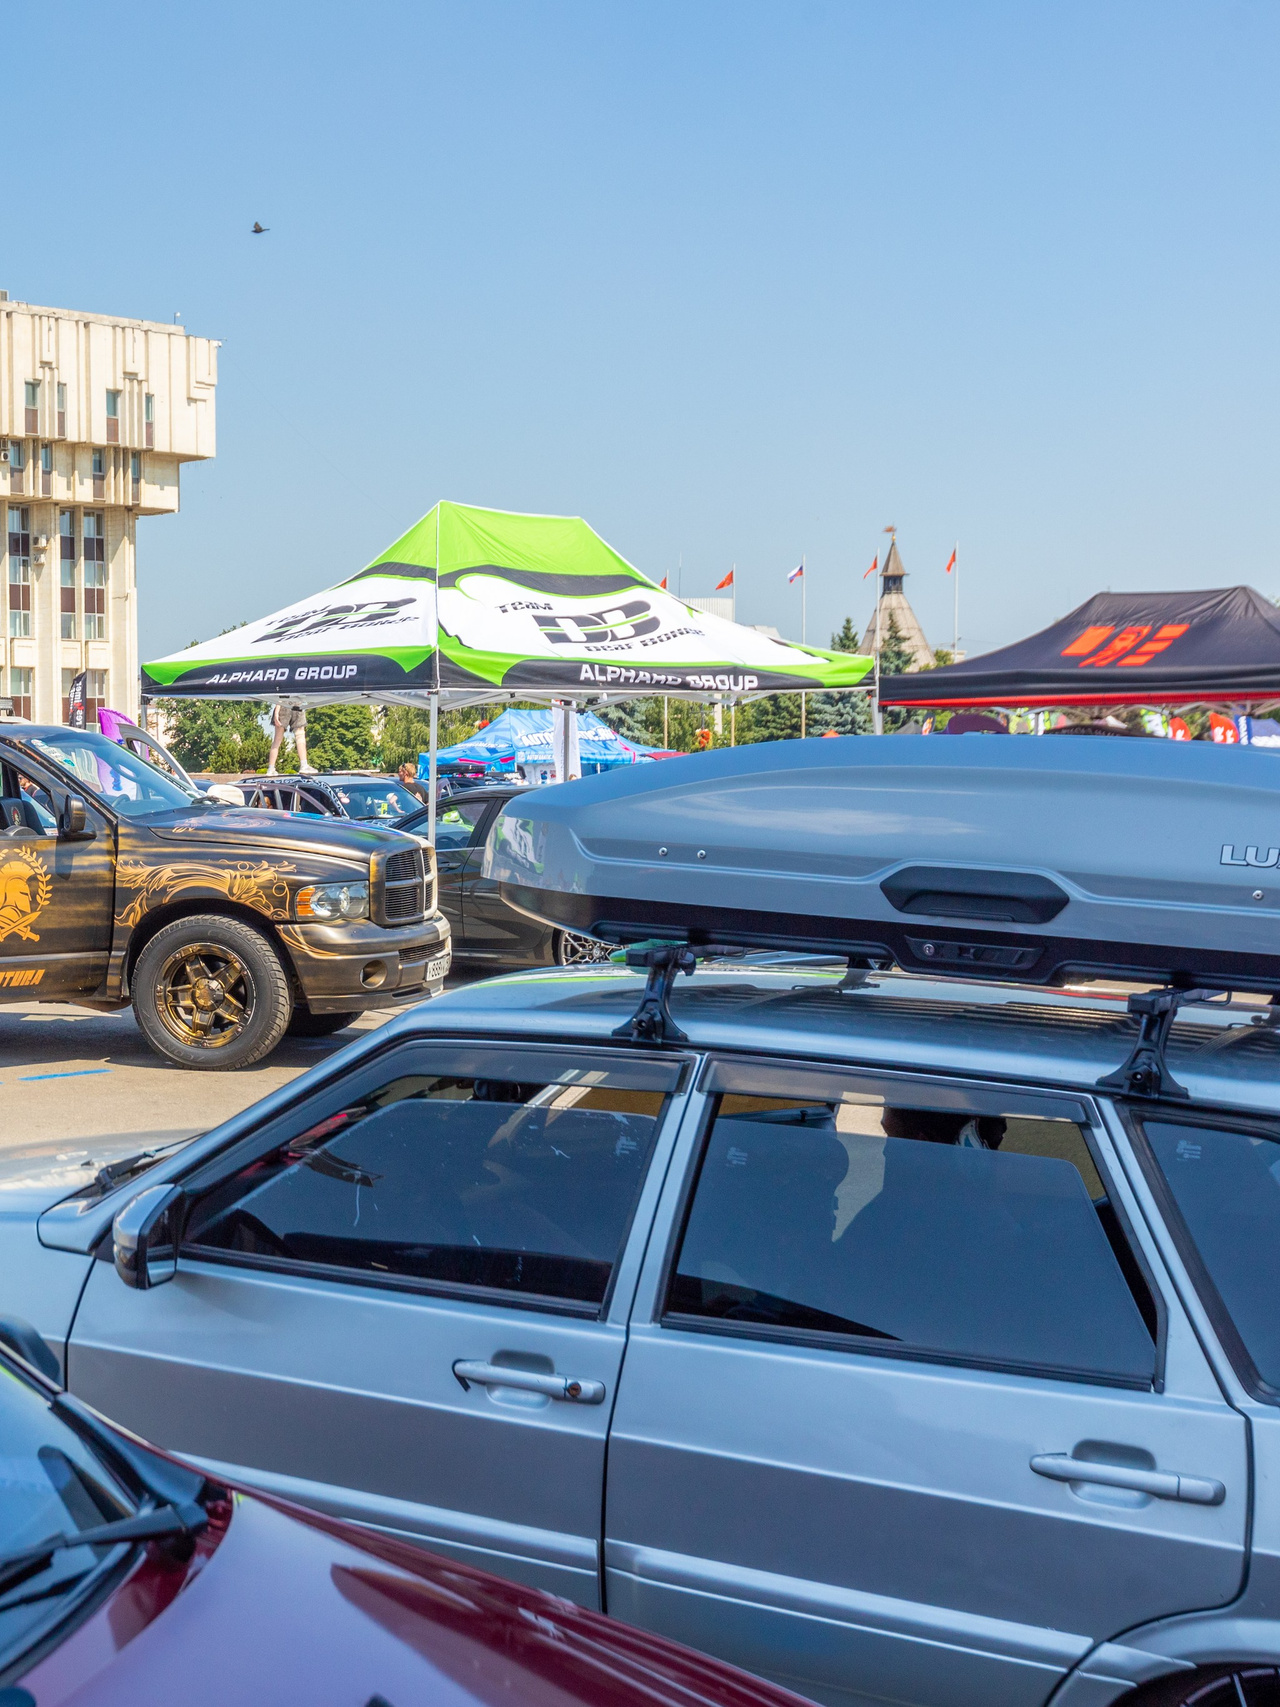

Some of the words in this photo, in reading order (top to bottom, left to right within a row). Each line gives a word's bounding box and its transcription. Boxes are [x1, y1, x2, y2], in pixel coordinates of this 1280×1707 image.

[206, 668, 289, 685] ALPHARD
[294, 665, 358, 681] GROUP
[579, 664, 682, 686] ALPHARD
[685, 674, 759, 691] GROUP
[1220, 844, 1280, 869] LU
